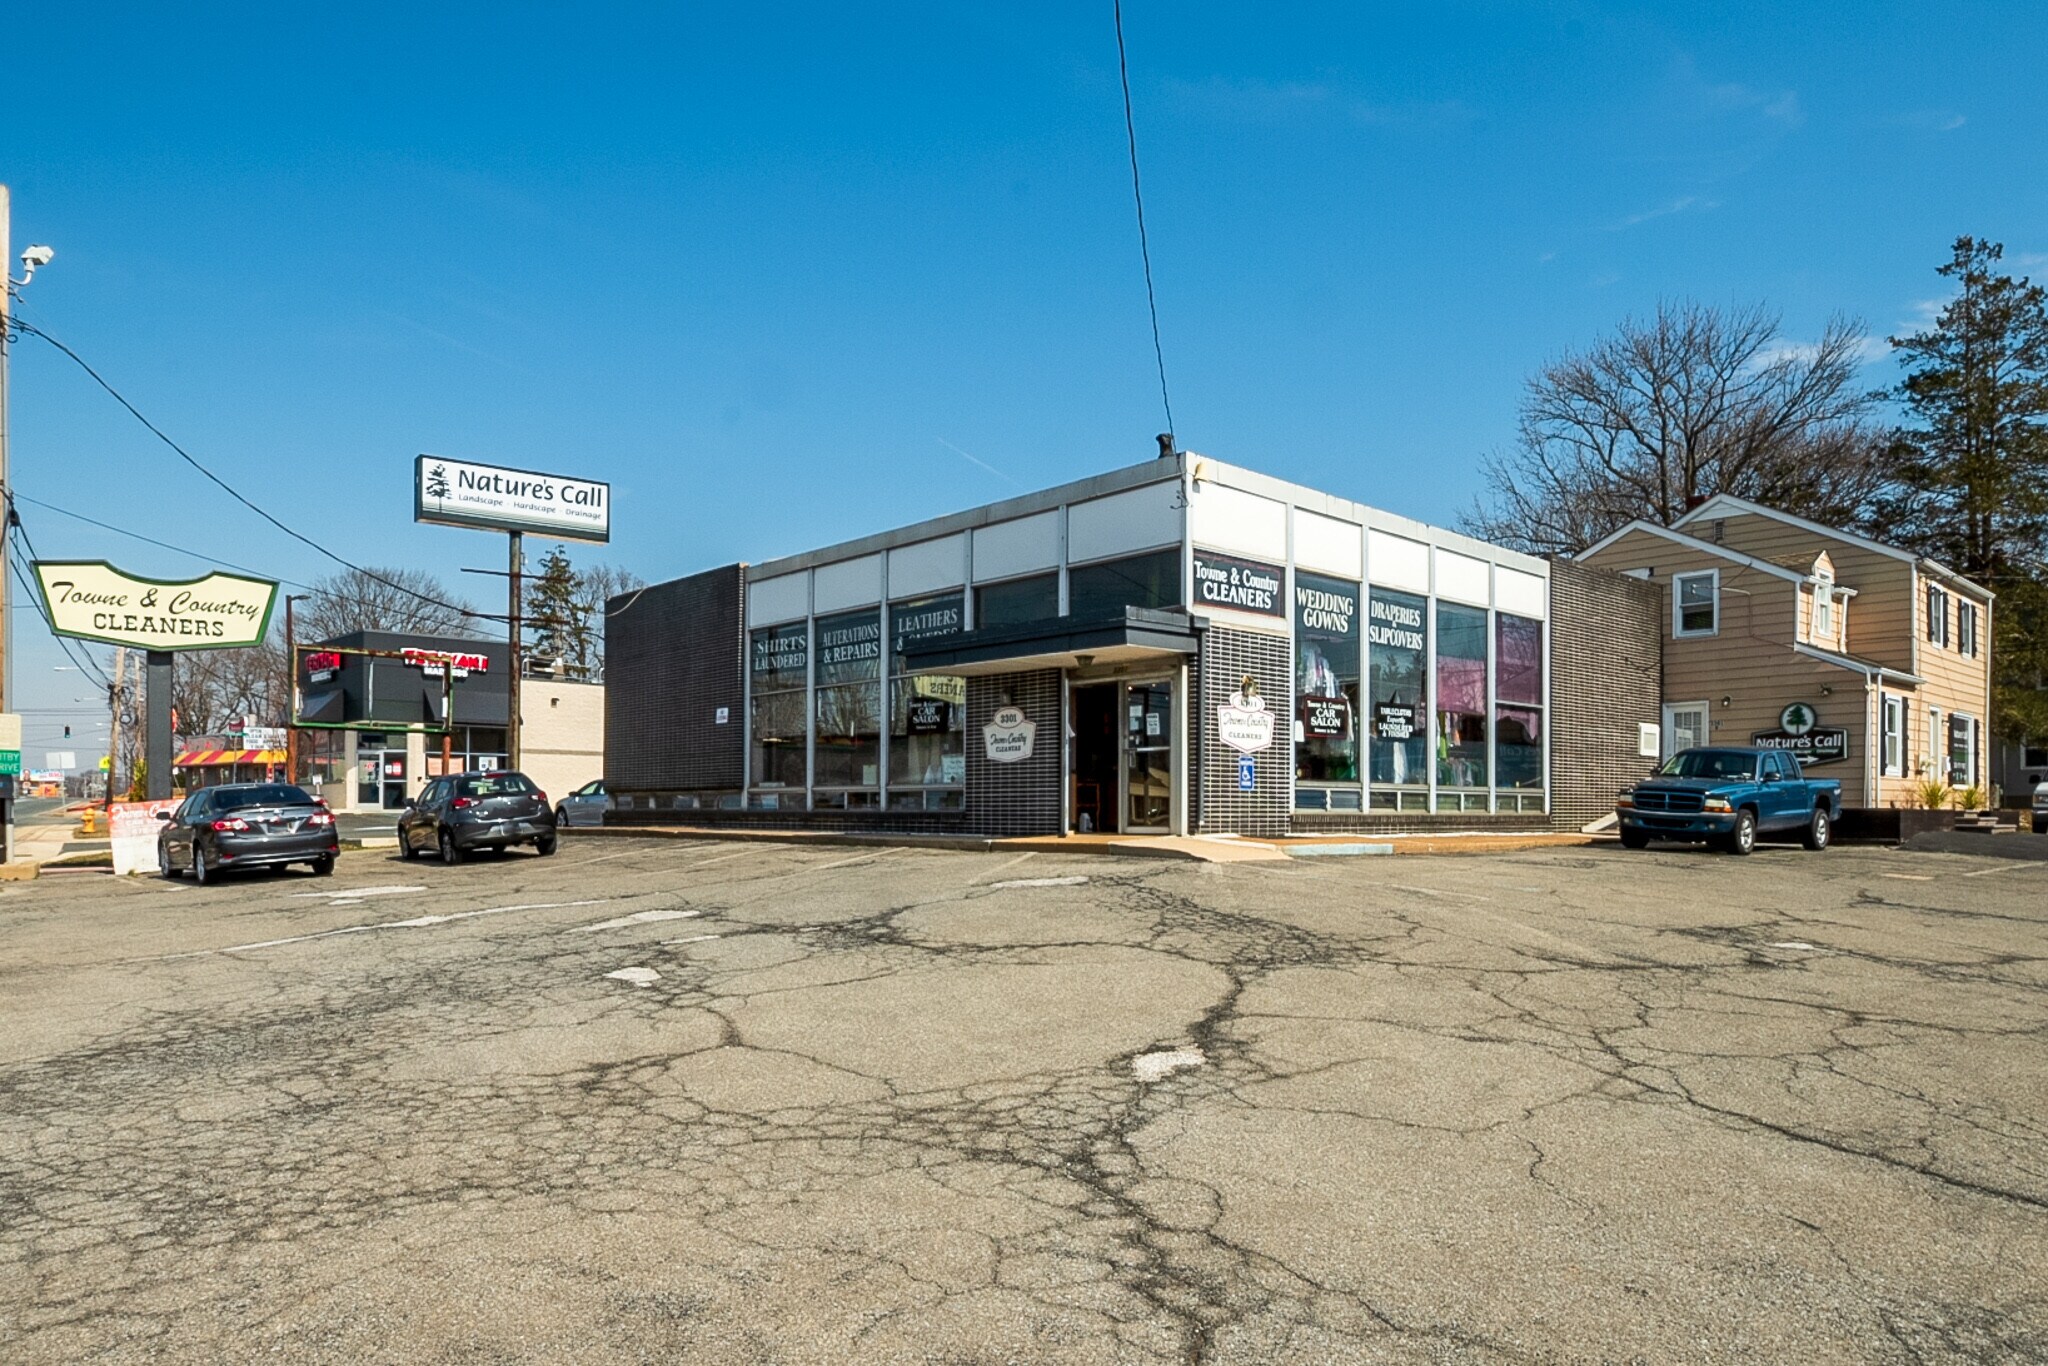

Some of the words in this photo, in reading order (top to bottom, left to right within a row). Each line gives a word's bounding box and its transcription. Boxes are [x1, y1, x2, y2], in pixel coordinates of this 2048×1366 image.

[459, 469, 554, 500] Nature's
[561, 485, 602, 507] Call
[458, 494, 503, 506] Landscape
[513, 501, 556, 514] Hardscape
[565, 508, 602, 520] Drainage
[1194, 561, 1228, 583] Towne
[1230, 567, 1240, 585] &
[1242, 569, 1279, 595] Country
[52, 581, 129, 608] Towne
[139, 588, 159, 608] &
[168, 591, 260, 621] Country
[1202, 581, 1272, 609] CLEANERS
[1296, 587, 1354, 616] WEDDING
[93, 613, 225, 637] CLEANERS
[898, 608, 958, 633] LEATHERS
[1303, 608, 1349, 633] GOWNS
[1370, 600, 1421, 627] DRAPERIES
[757, 635, 807, 654] SHIRTS
[822, 623, 879, 647] ALTERATIONS
[1369, 625, 1423, 650] SLIPCOVERS
[754, 652, 806, 671] LAUNDERED
[823, 648, 832, 663] &
[833, 641, 879, 662] REPAIRS
[913, 715, 940, 724] SALON
[917, 707, 936, 716] CAR
[1311, 716, 1341, 727] SALON
[1316, 707, 1336, 718] CAR
[1756, 734, 1811, 749] Nature's
[1814, 734, 1842, 748] Call
